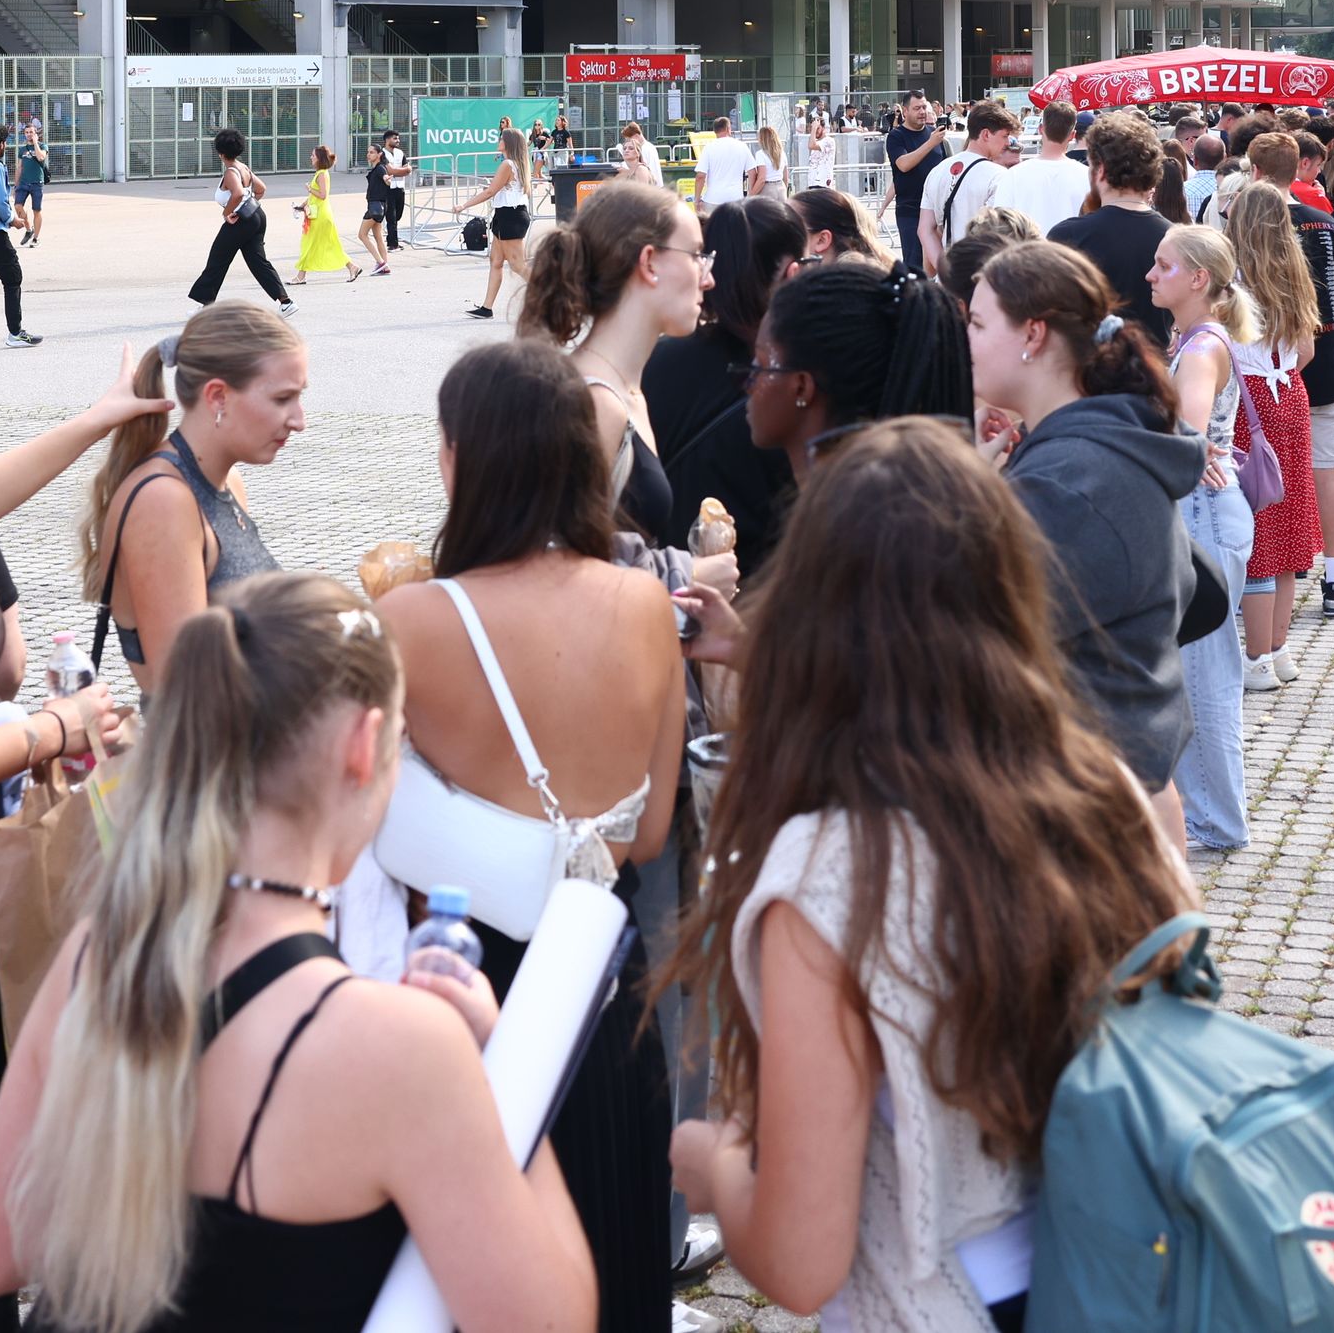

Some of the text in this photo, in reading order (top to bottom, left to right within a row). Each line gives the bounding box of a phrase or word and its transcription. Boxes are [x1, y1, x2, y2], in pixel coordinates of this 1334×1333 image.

[580, 60, 616, 76] Sektor B
[637, 57, 650, 68] Rang
[236, 66, 297, 76] Stadion Betriebsleitung
[630, 68, 647, 79] Stiege
[178, 76, 188, 85] MA
[189, 76, 196, 85] 31
[199, 76, 209, 85] MA
[210, 76, 217, 85] 23
[221, 76, 230, 85] MA
[231, 76, 238, 85] 51
[242, 76, 252, 85] MA
[279, 76, 289, 85] MA
[289, 76, 297, 85] 35
[1158, 63, 1274, 96] BREZEL
